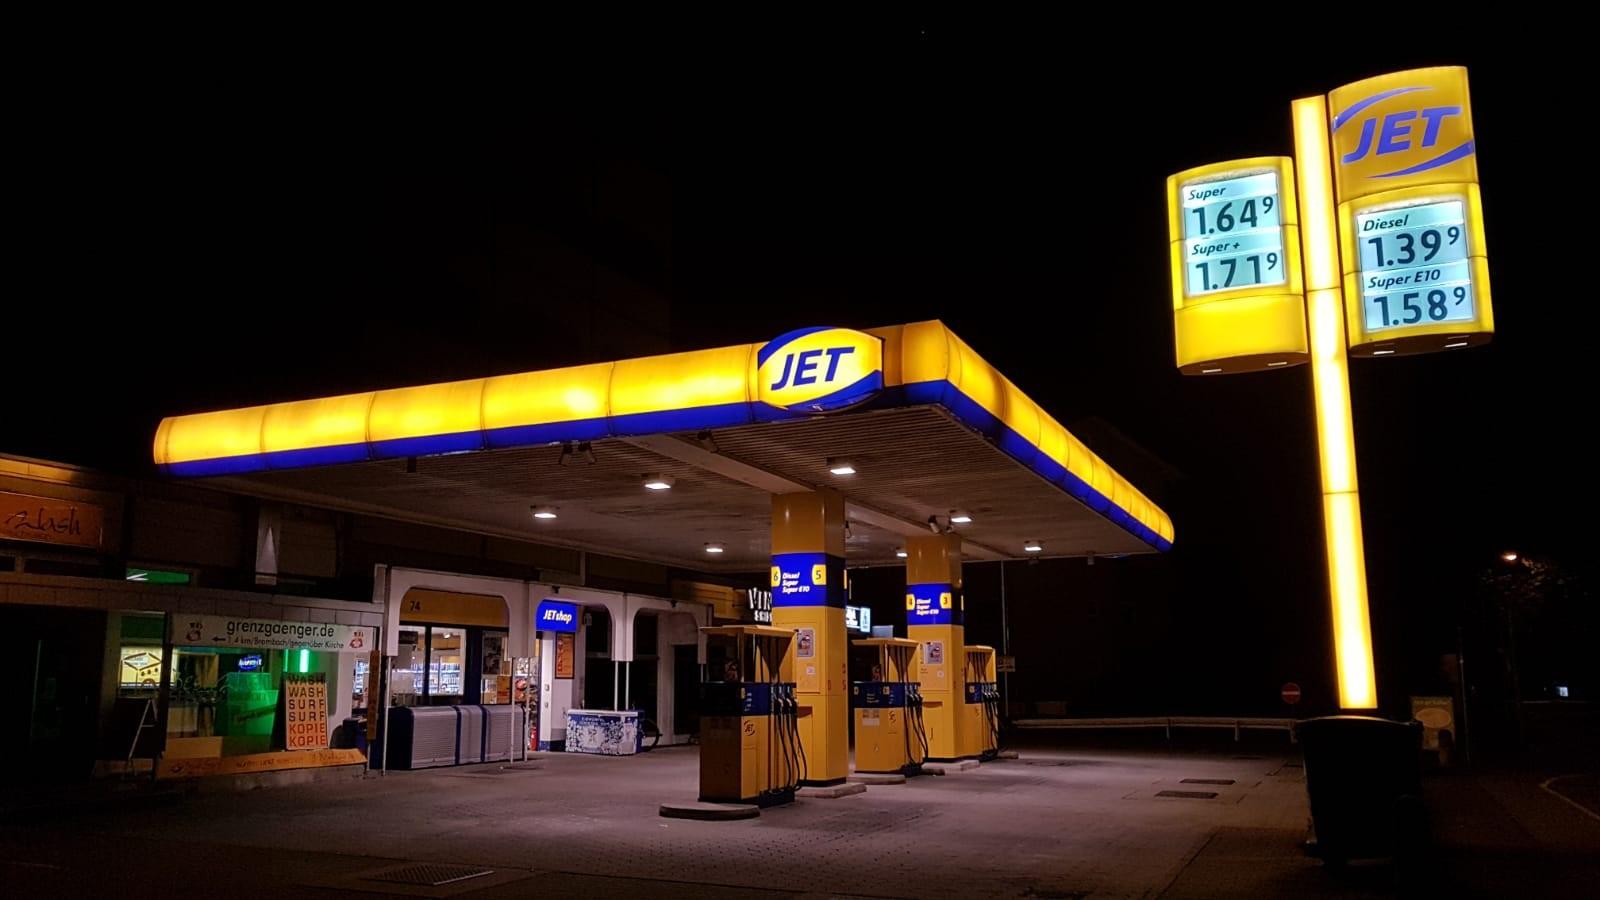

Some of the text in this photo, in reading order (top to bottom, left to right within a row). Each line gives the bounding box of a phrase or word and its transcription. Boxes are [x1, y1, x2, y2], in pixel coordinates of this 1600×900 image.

[1342, 107, 1462, 164] JET
[1187, 187, 1226, 201] Super
[1363, 214, 1409, 232] Diesel
[1190, 243, 1231, 256] Super
[1368, 268, 1441, 290] Super E10
[770, 346, 856, 391] JET
[773, 569, 822, 582] 6 5
[943, 597, 948, 605] 3
[227, 620, 334, 638] grenzgaenger.de
[288, 673, 324, 685] WASH
[288, 687, 324, 698] WASH
[289, 699, 324, 710] SURF
[289, 711, 325, 722] SURF
[289, 723, 325, 735] KOPIE
[289, 735, 326, 747] KOPIE
